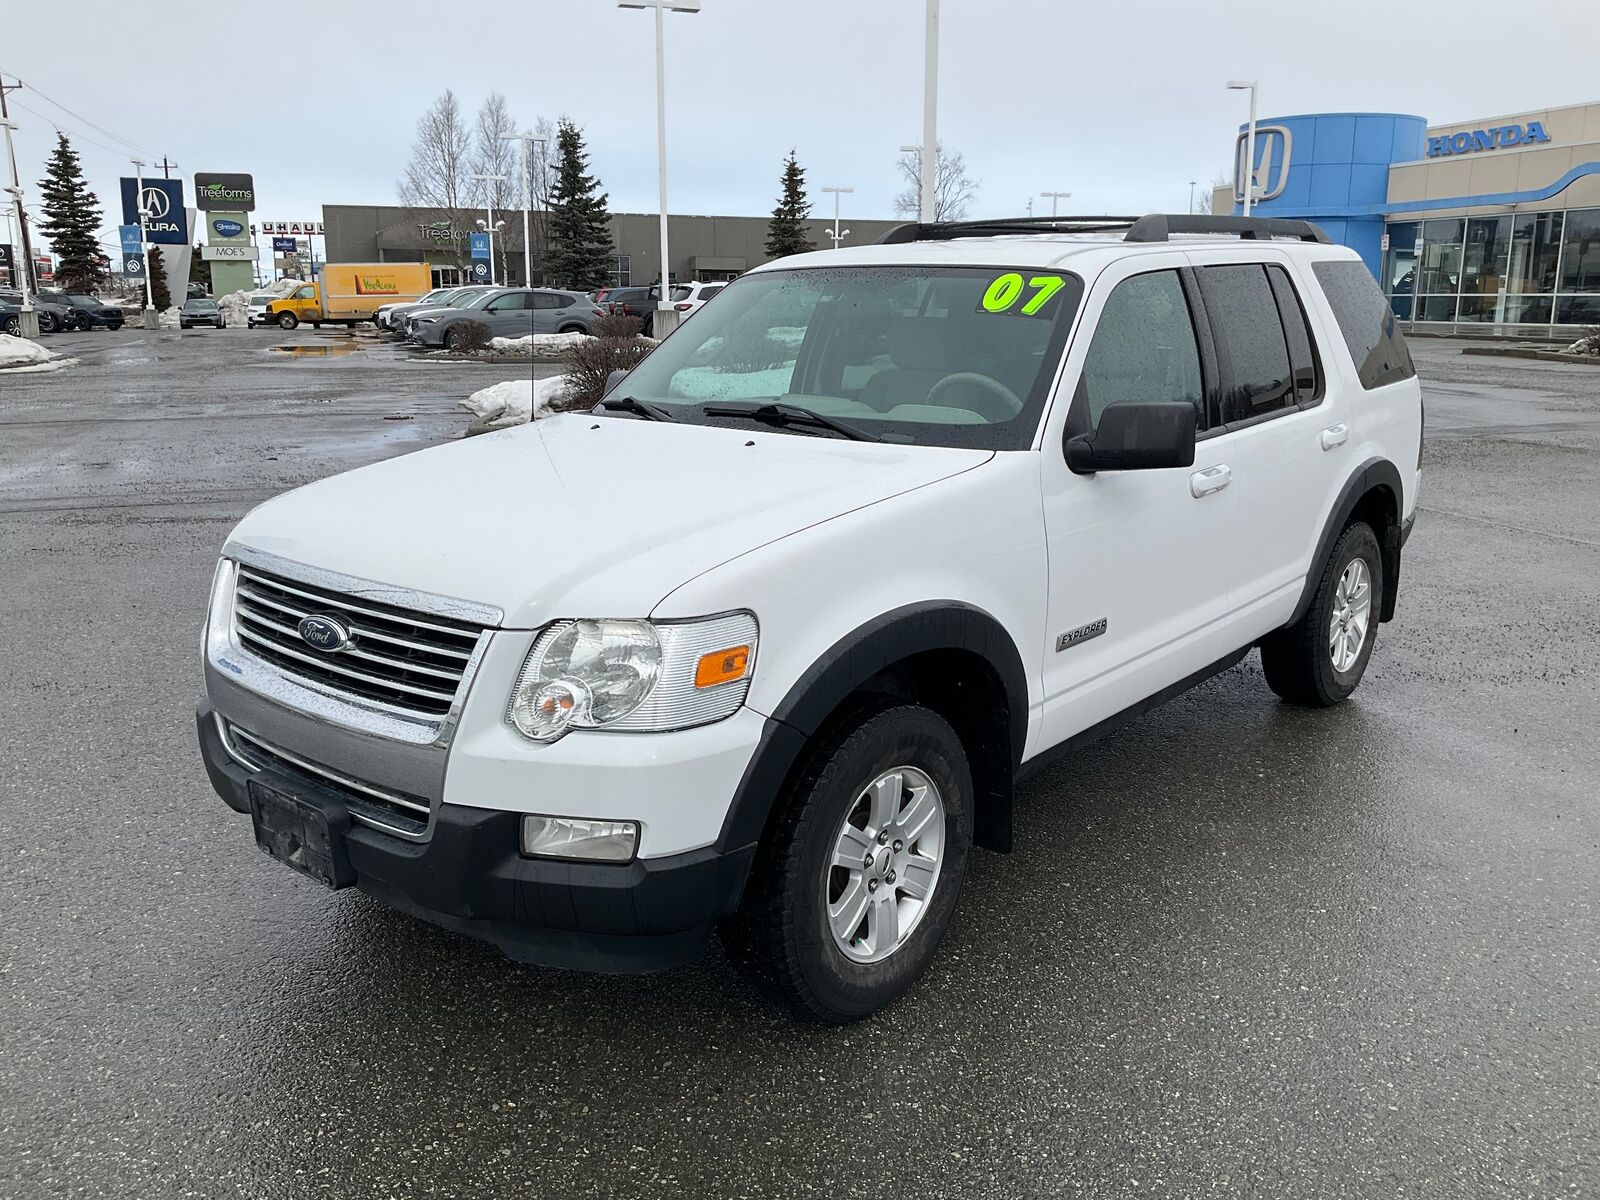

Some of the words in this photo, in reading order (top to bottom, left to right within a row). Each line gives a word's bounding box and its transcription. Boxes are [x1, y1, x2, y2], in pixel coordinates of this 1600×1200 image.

[1427, 121, 1551, 157] HONDA
[197, 185, 252, 199] Treeforms
[132, 222, 180, 232] CURA
[215, 247, 245, 256] MOE'S
[982, 272, 1066, 316] 07
[303, 620, 332, 647] Ford
[1061, 619, 1108, 645] EXPLORER
